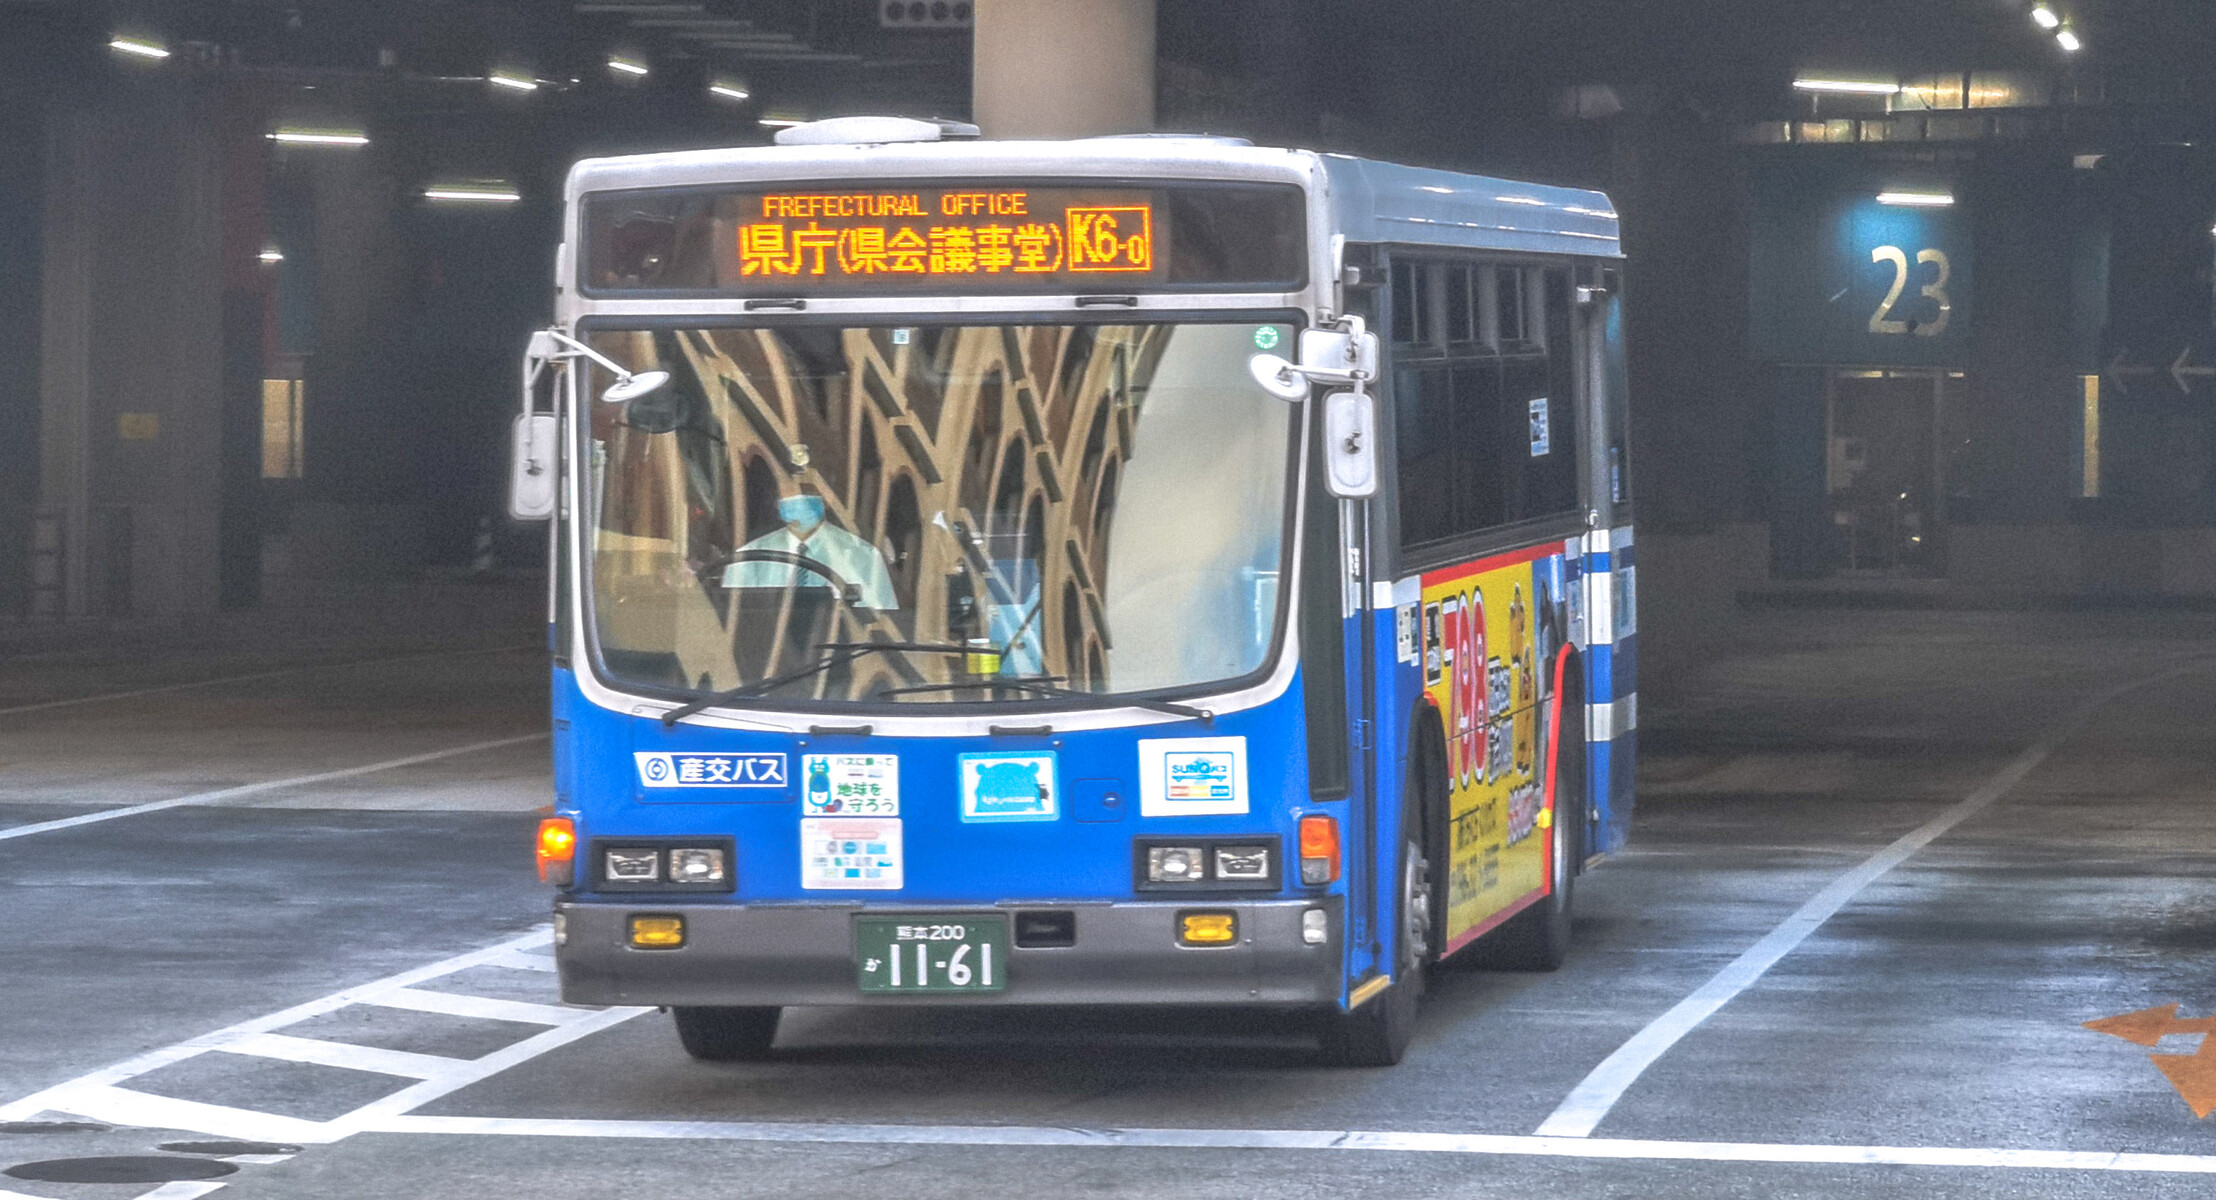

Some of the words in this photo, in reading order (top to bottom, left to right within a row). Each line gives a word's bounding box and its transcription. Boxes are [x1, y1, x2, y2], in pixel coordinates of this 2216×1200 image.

[762, 194, 930, 218] FREFECTURAL
[941, 192, 1029, 216] OFFICE
[739, 222, 1064, 275] 県庁(県会議事堂)
[1868, 245, 1951, 337] 23
[679, 757, 784, 783] 産交バス
[848, 798, 895, 813] 守ろう
[890, 943, 992, 986] 11-61
